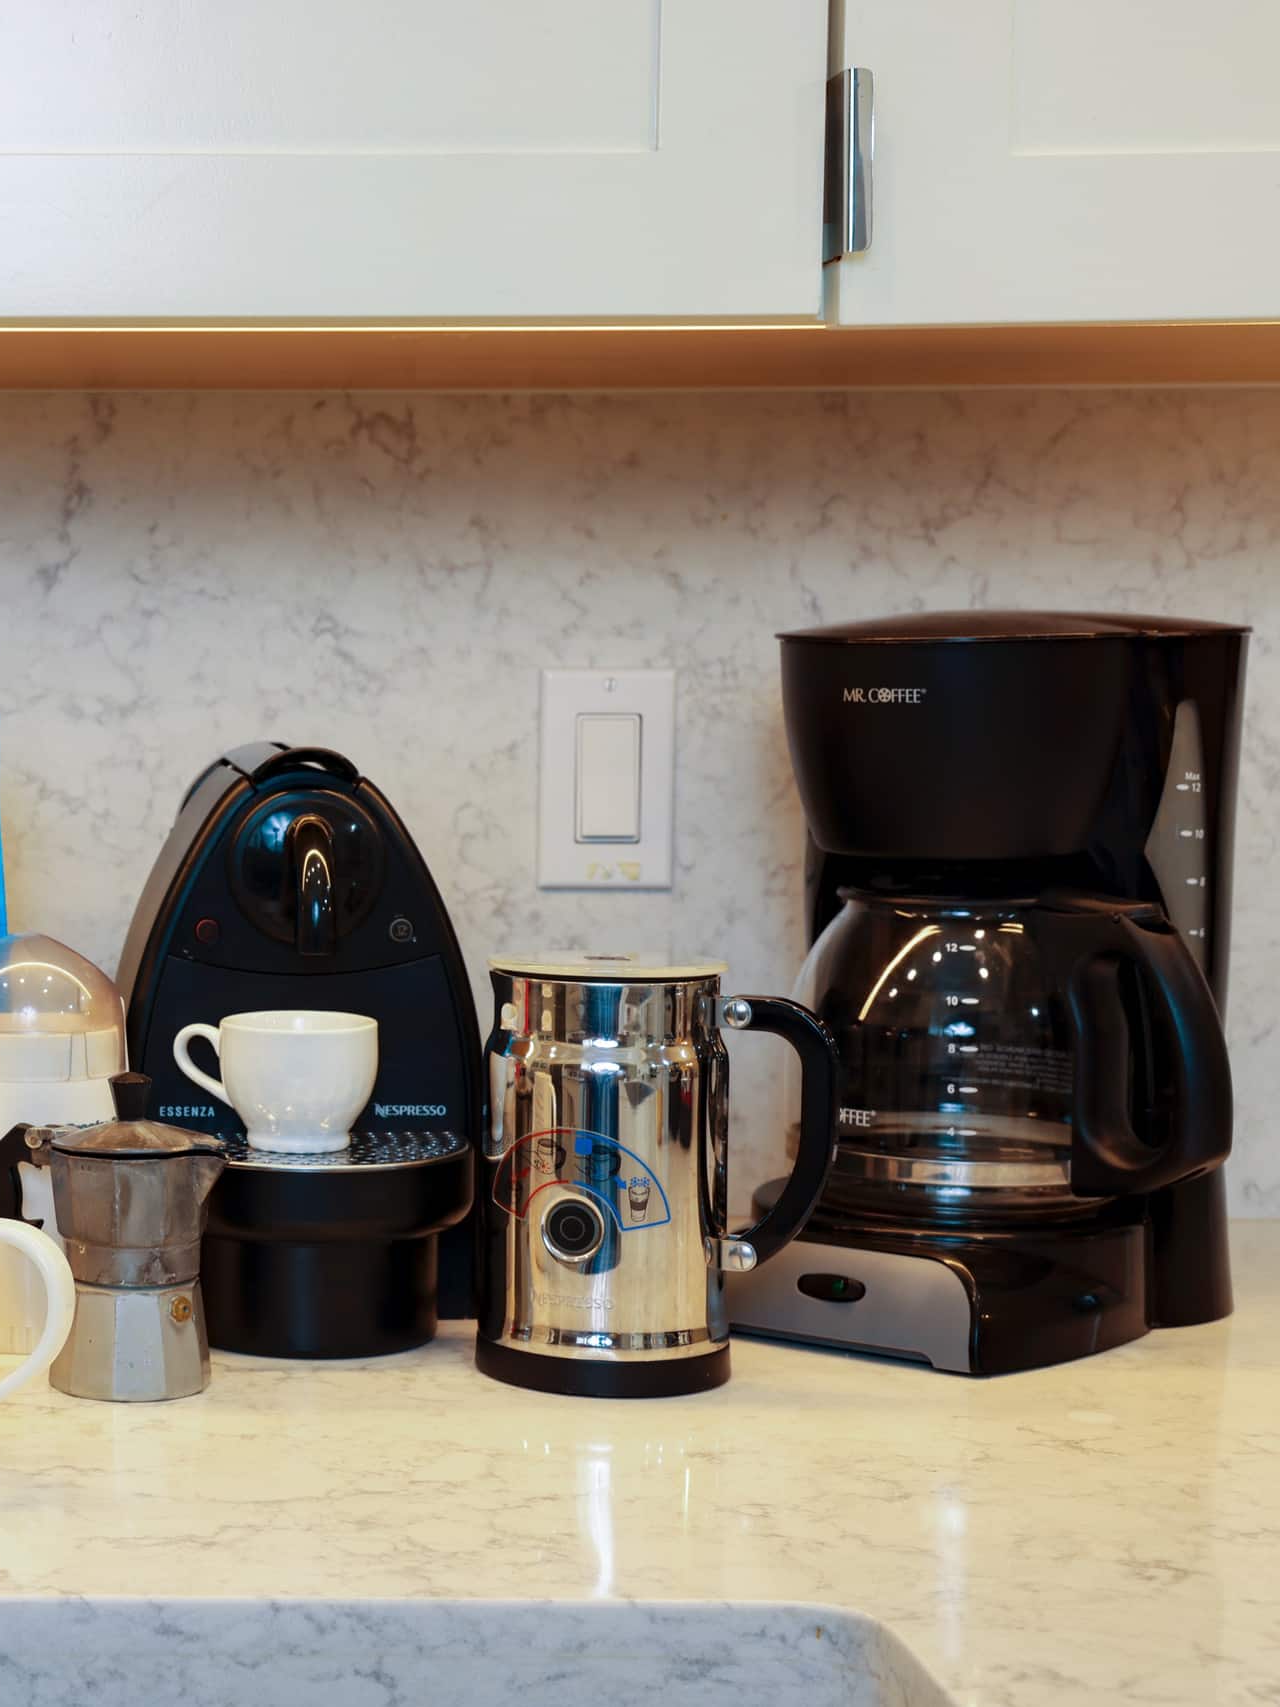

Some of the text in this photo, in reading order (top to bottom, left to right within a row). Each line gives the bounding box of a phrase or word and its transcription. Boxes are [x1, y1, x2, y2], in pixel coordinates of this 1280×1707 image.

[843, 688, 921, 703] MR. COFFEE
[1192, 783, 1201, 792] 12
[945, 943, 958, 952] 12
[946, 995, 958, 1006] 10
[947, 1043, 956, 1054] 8
[947, 1083, 956, 1094] 6
[159, 1105, 215, 1117] ESSENZA
[375, 1103, 447, 1118] NESPRESSO
